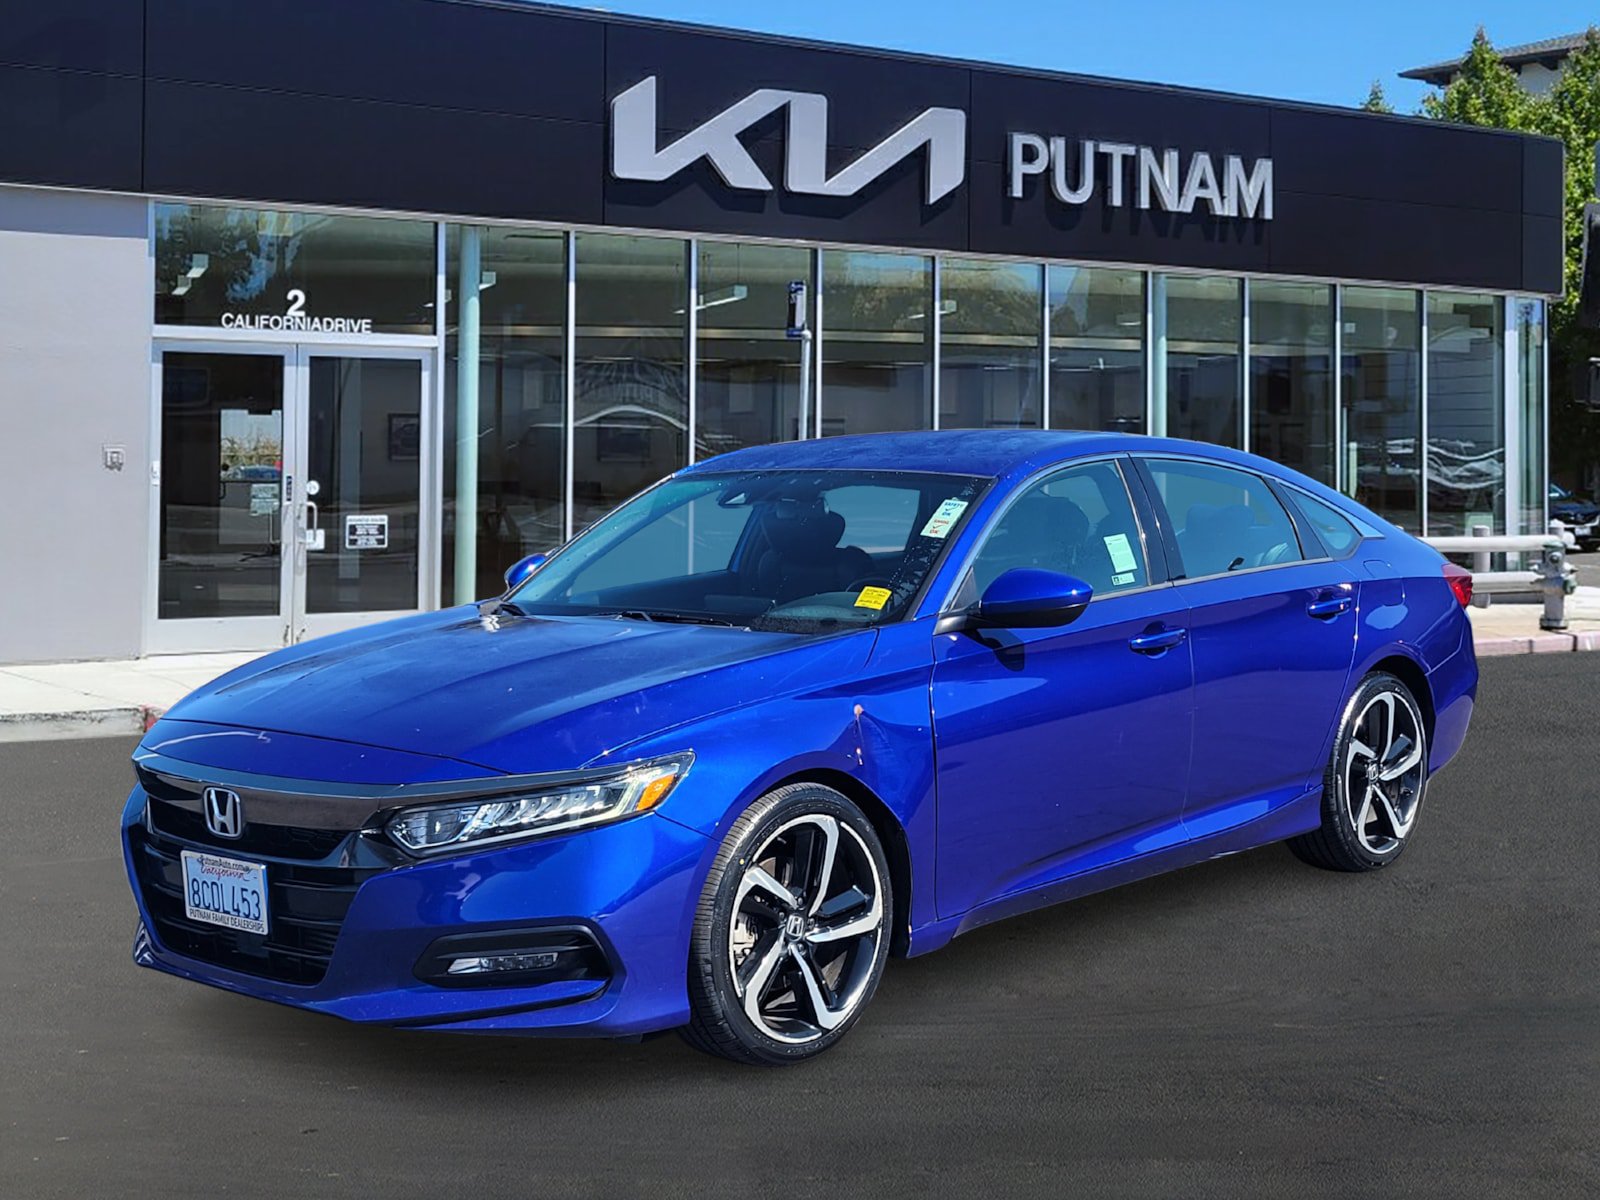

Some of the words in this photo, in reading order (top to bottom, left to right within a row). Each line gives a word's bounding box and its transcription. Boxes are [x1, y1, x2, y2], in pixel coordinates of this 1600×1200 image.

[610, 76, 966, 205] KIA
[1007, 131, 1274, 220] PUTNAM
[286, 289, 306, 316] 2
[189, 908, 212, 921] PUTNAM
[212, 913, 230, 925] FAMILY
[230, 917, 265, 933] DEALERSHIPS
